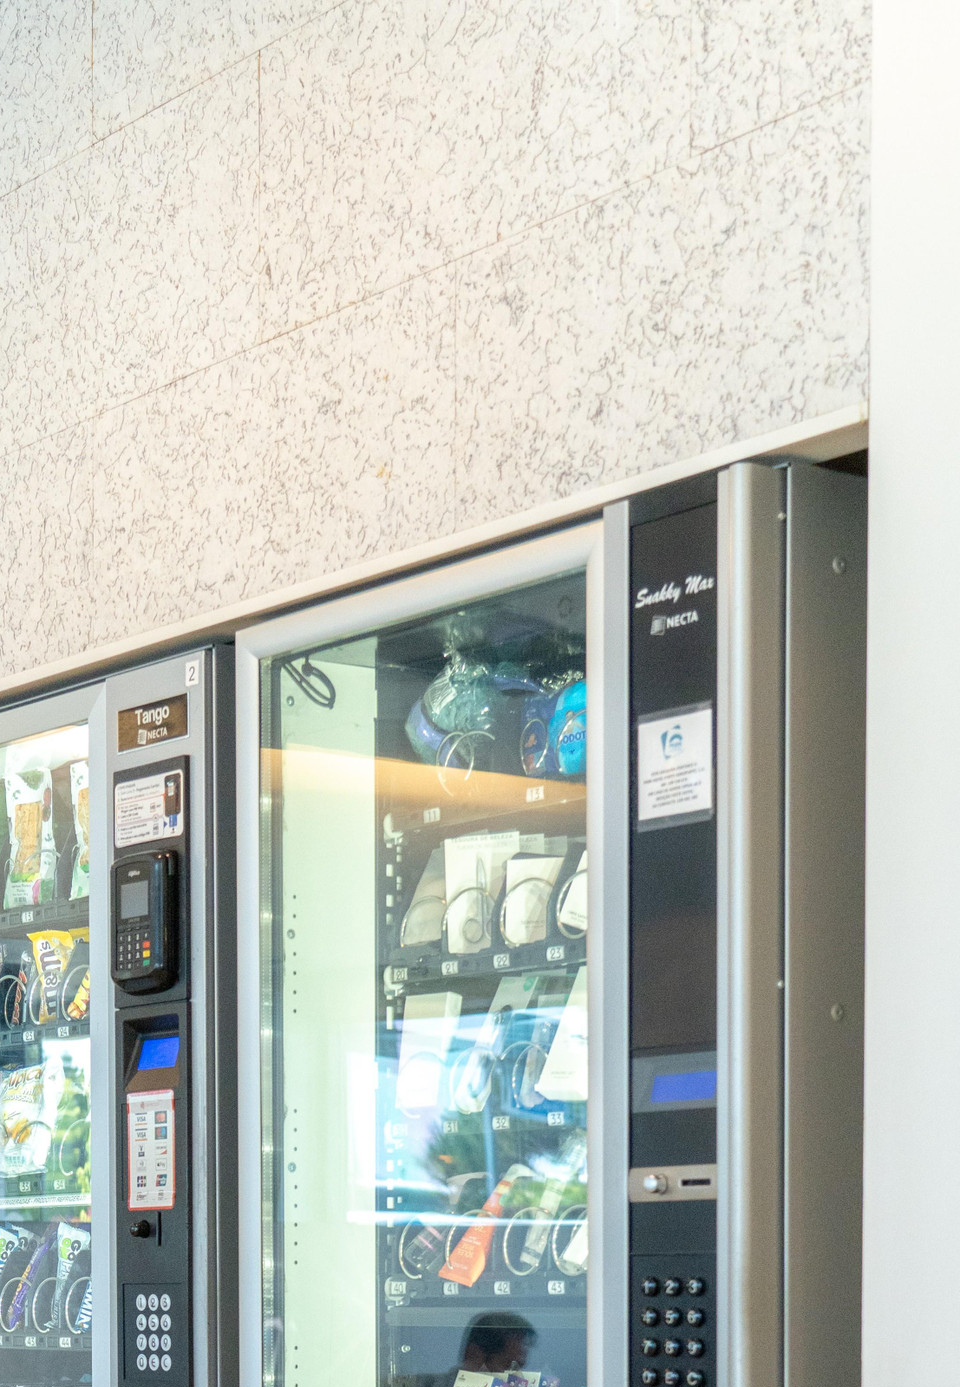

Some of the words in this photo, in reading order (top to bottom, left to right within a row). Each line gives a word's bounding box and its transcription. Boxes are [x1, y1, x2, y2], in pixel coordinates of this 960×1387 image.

[666, 610, 699, 629] NECTA
[188, 666, 195, 682] 2
[134, 705, 170, 726] Tango
[147, 726, 168, 740] NECTA
[427, 809, 438, 821] 11
[549, 948, 562, 960] 23
[445, 962, 456, 974] 21
[496, 956, 508, 968] 22
[495, 1116, 508, 1129] 32
[549, 1112, 562, 1125] 33
[393, 1283, 404, 1294] 40
[446, 1283, 457, 1294] 41
[497, 1282, 509, 1294] 42
[550, 1282, 563, 1293] 43
